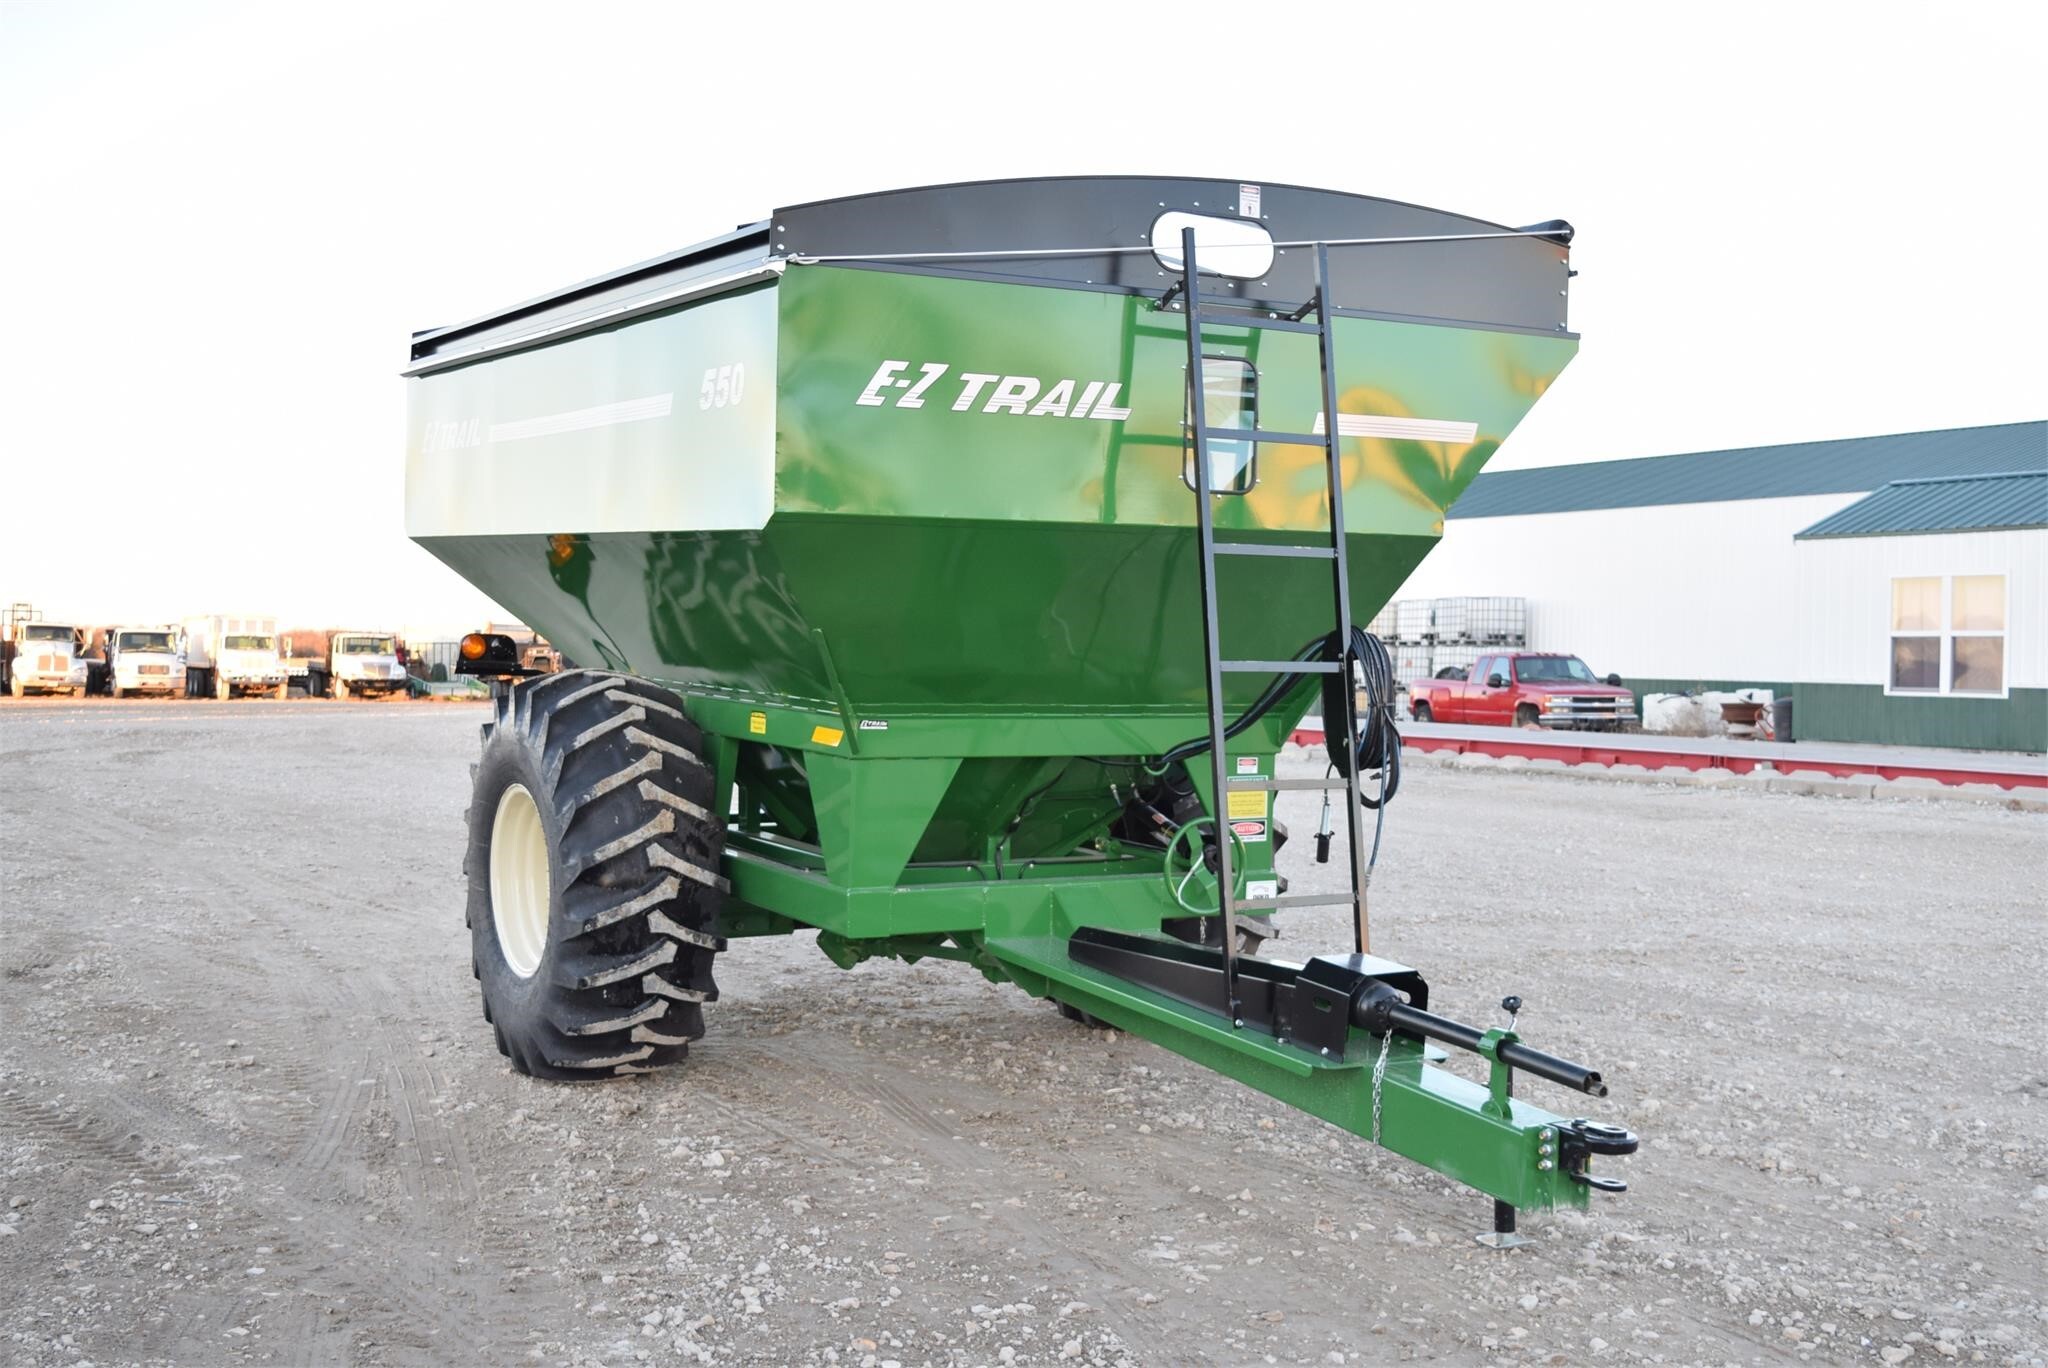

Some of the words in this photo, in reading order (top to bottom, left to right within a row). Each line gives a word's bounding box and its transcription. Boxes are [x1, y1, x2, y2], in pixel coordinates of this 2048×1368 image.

[699, 362, 745, 411] 550
[855, 359, 950, 409] E-Z
[951, 372, 1133, 422] TRAIL
[440, 415, 481, 448] TRAIL
